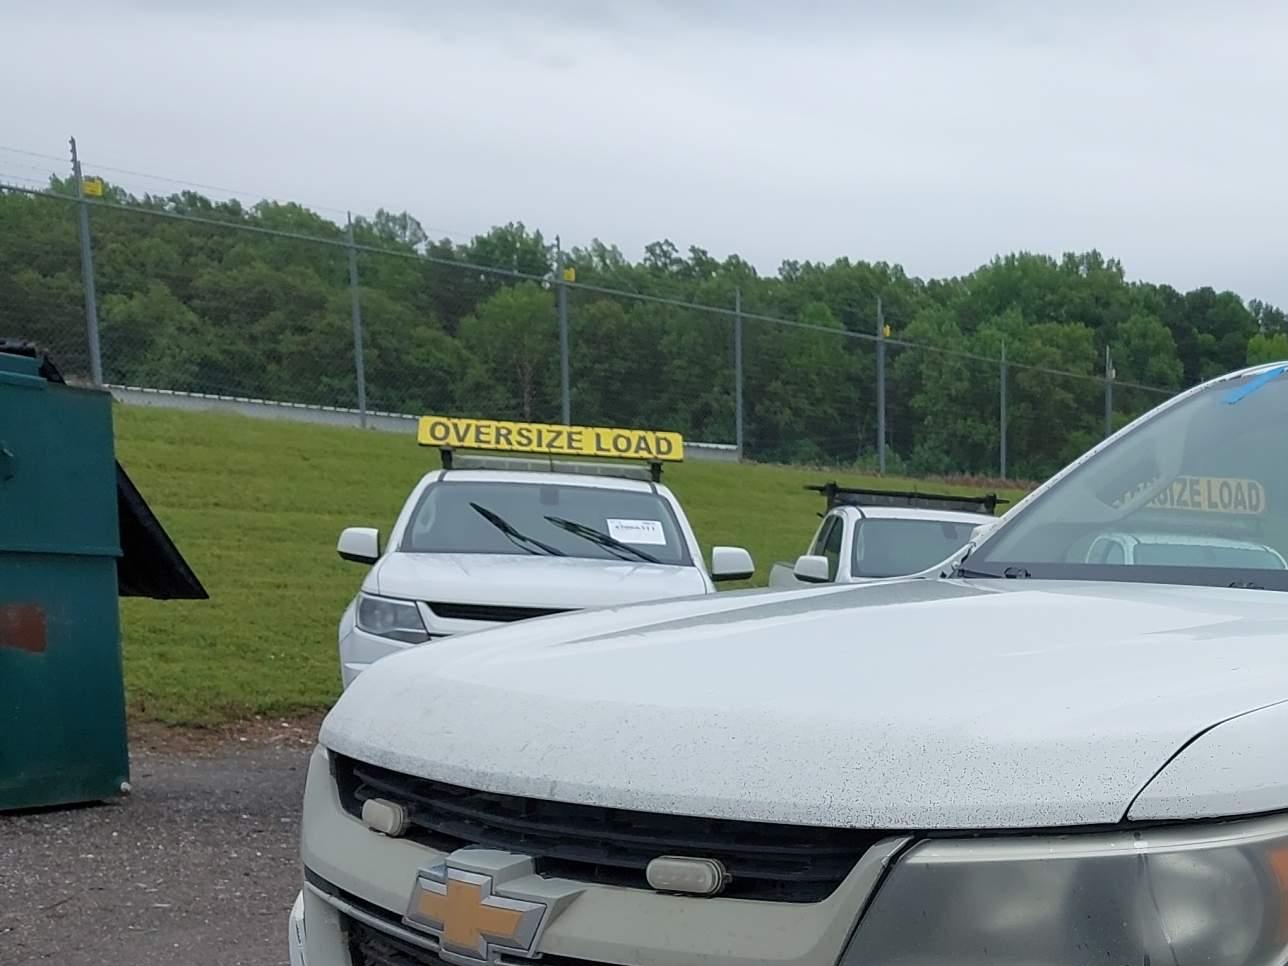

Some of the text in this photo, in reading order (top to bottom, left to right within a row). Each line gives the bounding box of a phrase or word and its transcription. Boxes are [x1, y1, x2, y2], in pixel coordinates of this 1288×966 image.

[429, 421, 673, 456] OVERSIZE LOAD
[1206, 479, 1262, 513] LOAD
